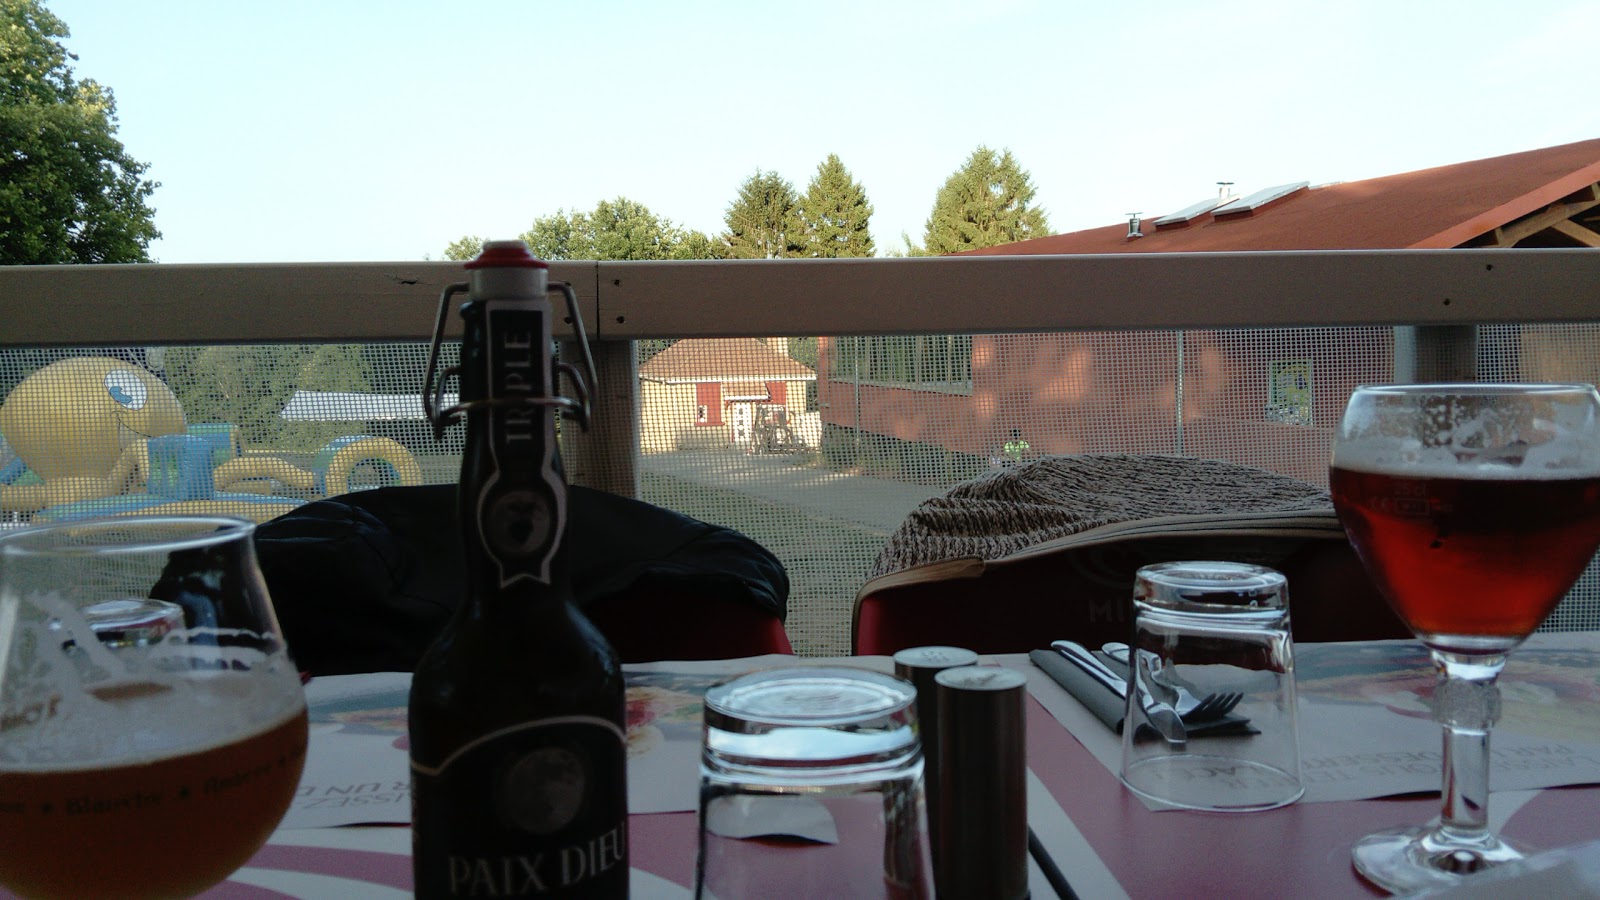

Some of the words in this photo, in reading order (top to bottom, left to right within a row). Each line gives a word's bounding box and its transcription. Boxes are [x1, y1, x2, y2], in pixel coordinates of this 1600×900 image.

[504, 331, 535, 444] TRPLE
[449, 853, 550, 897] PAIX
[561, 820, 626, 887] DIEU
